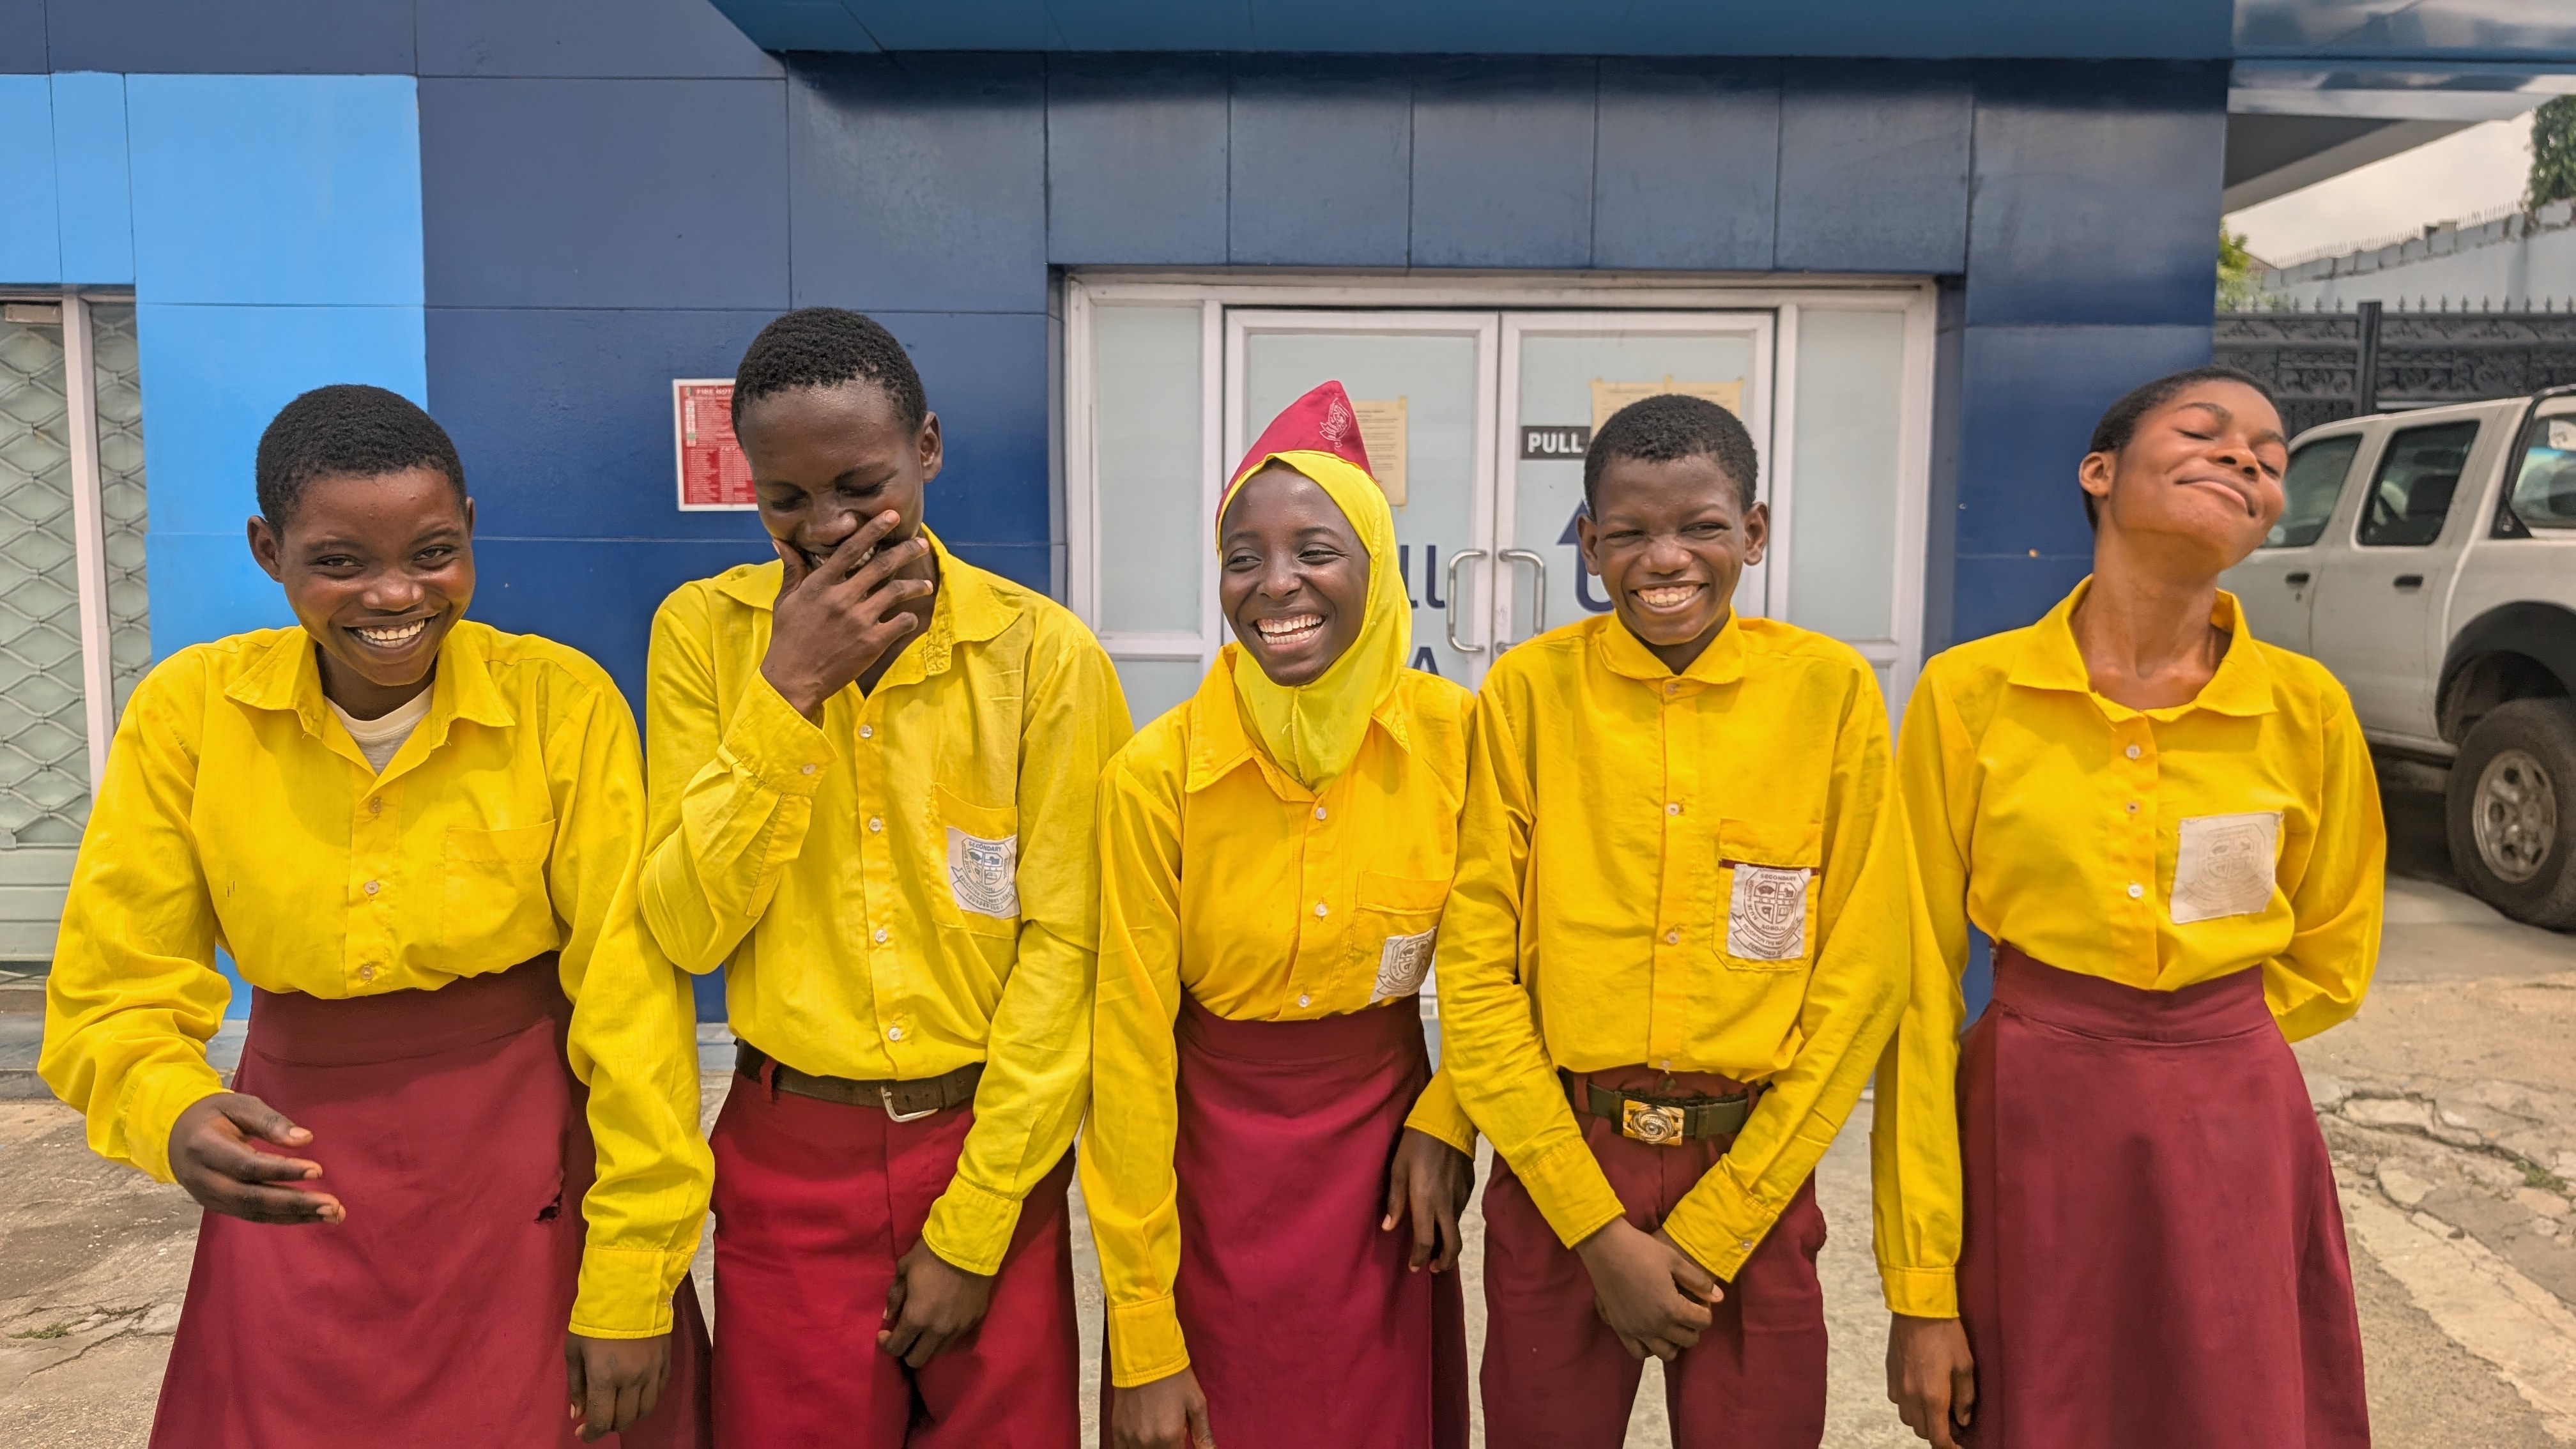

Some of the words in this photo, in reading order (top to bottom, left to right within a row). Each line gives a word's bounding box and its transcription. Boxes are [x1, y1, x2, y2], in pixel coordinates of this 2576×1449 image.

[1527, 431, 1584, 454] PULL
[969, 841, 1002, 852] SECONDARY
[965, 893, 990, 909] FOUNDED
